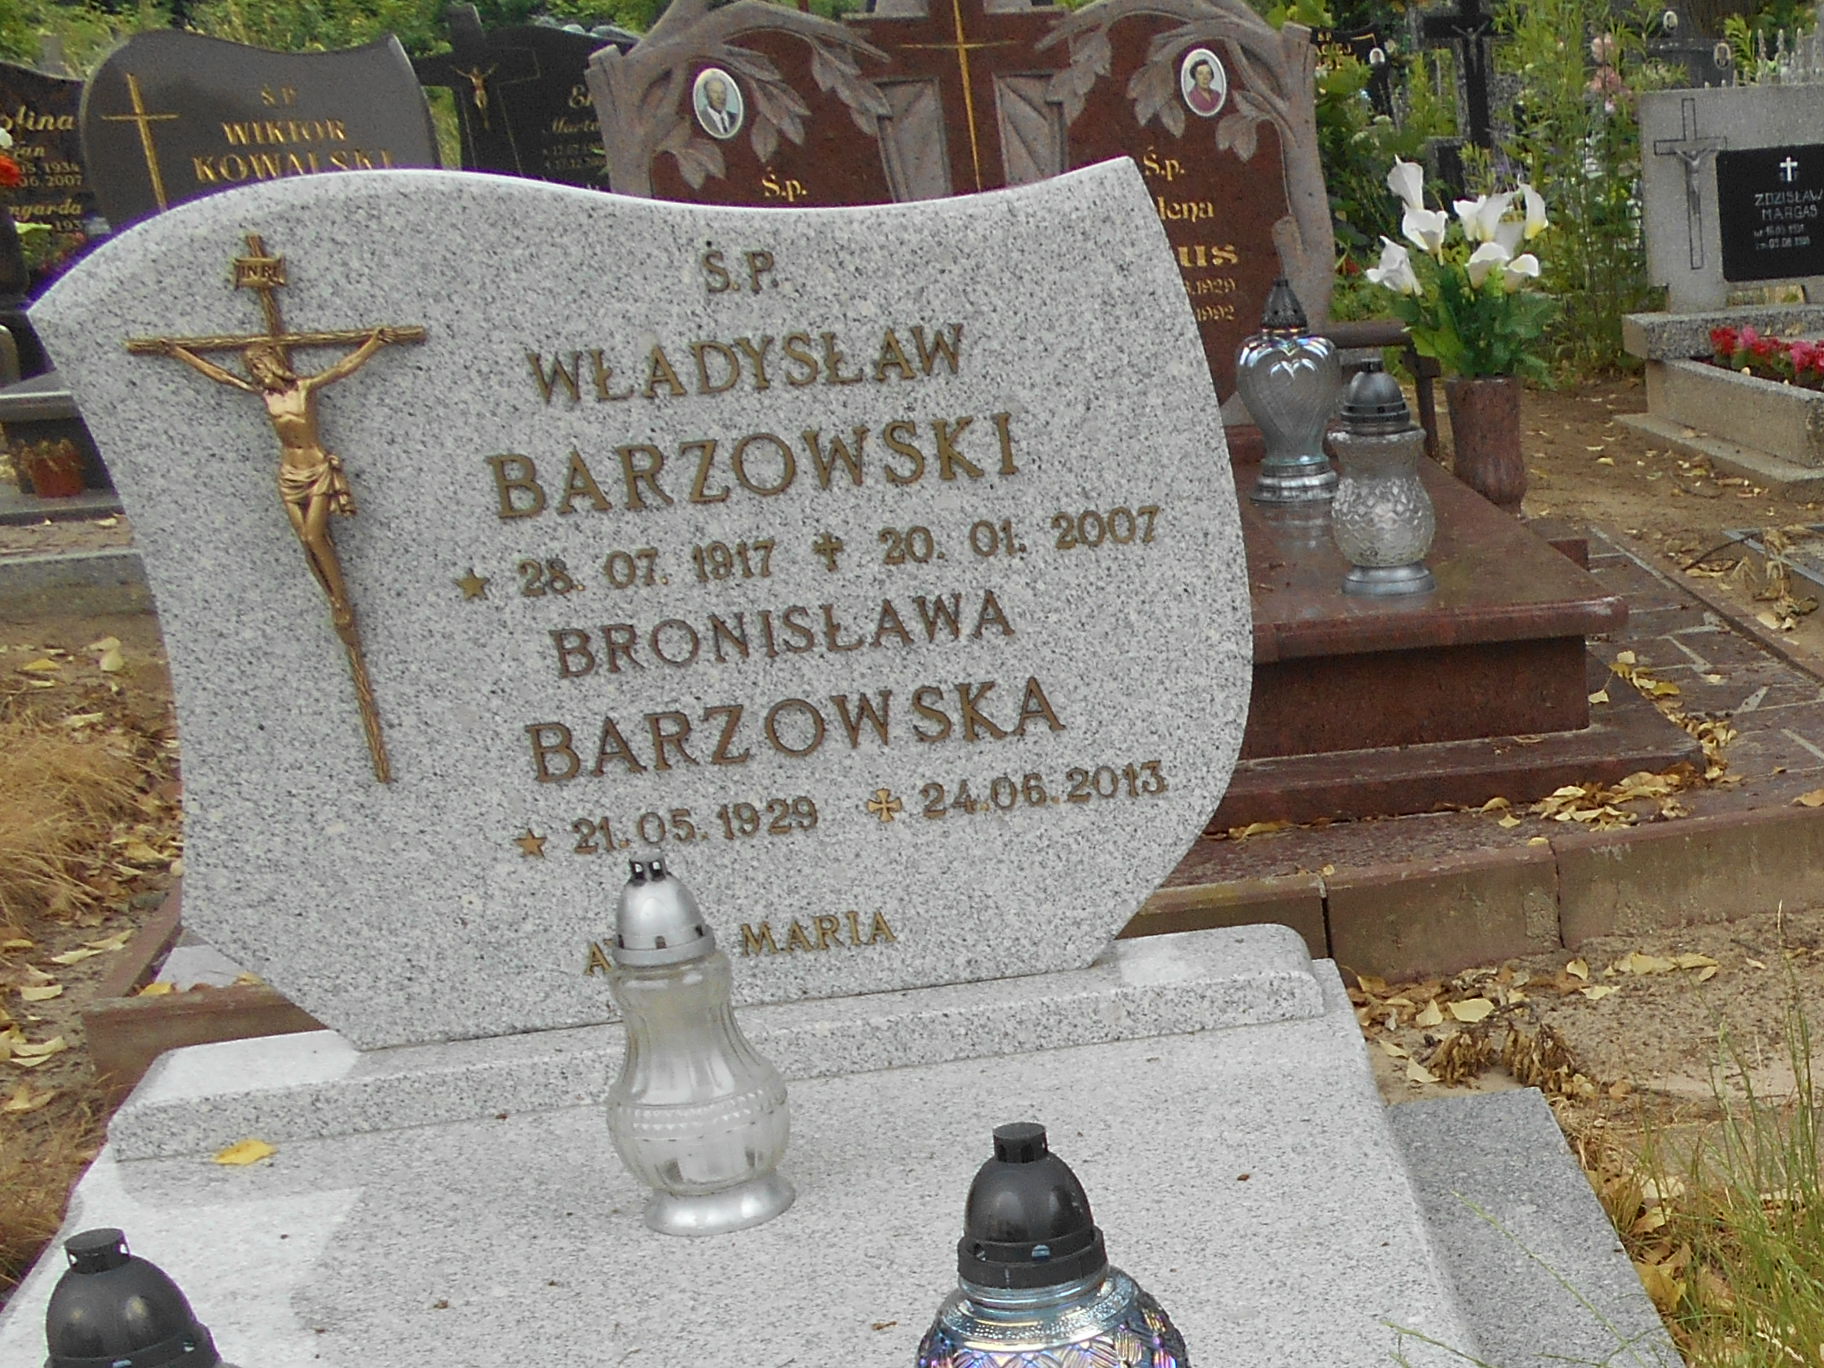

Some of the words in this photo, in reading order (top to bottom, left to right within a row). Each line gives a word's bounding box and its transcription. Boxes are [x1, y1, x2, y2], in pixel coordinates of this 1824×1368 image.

[221, 118, 347, 146] WIKTOR
[761, 166, 808, 202] Ś.p.
[1143, 146, 1185, 181] Ś.p.
[1157, 196, 1214, 223] lena
[526, 322, 965, 405] WŁADYSŁAW
[485, 411, 1020, 520] BARZOWSKI
[692, 539, 776, 582] 1917
[1051, 504, 1160, 552] 2007
[549, 588, 1015, 679] BRONISŁAWA
[525, 676, 1065, 784] BARZOWSKA
[741, 910, 897, 957] MARIA
